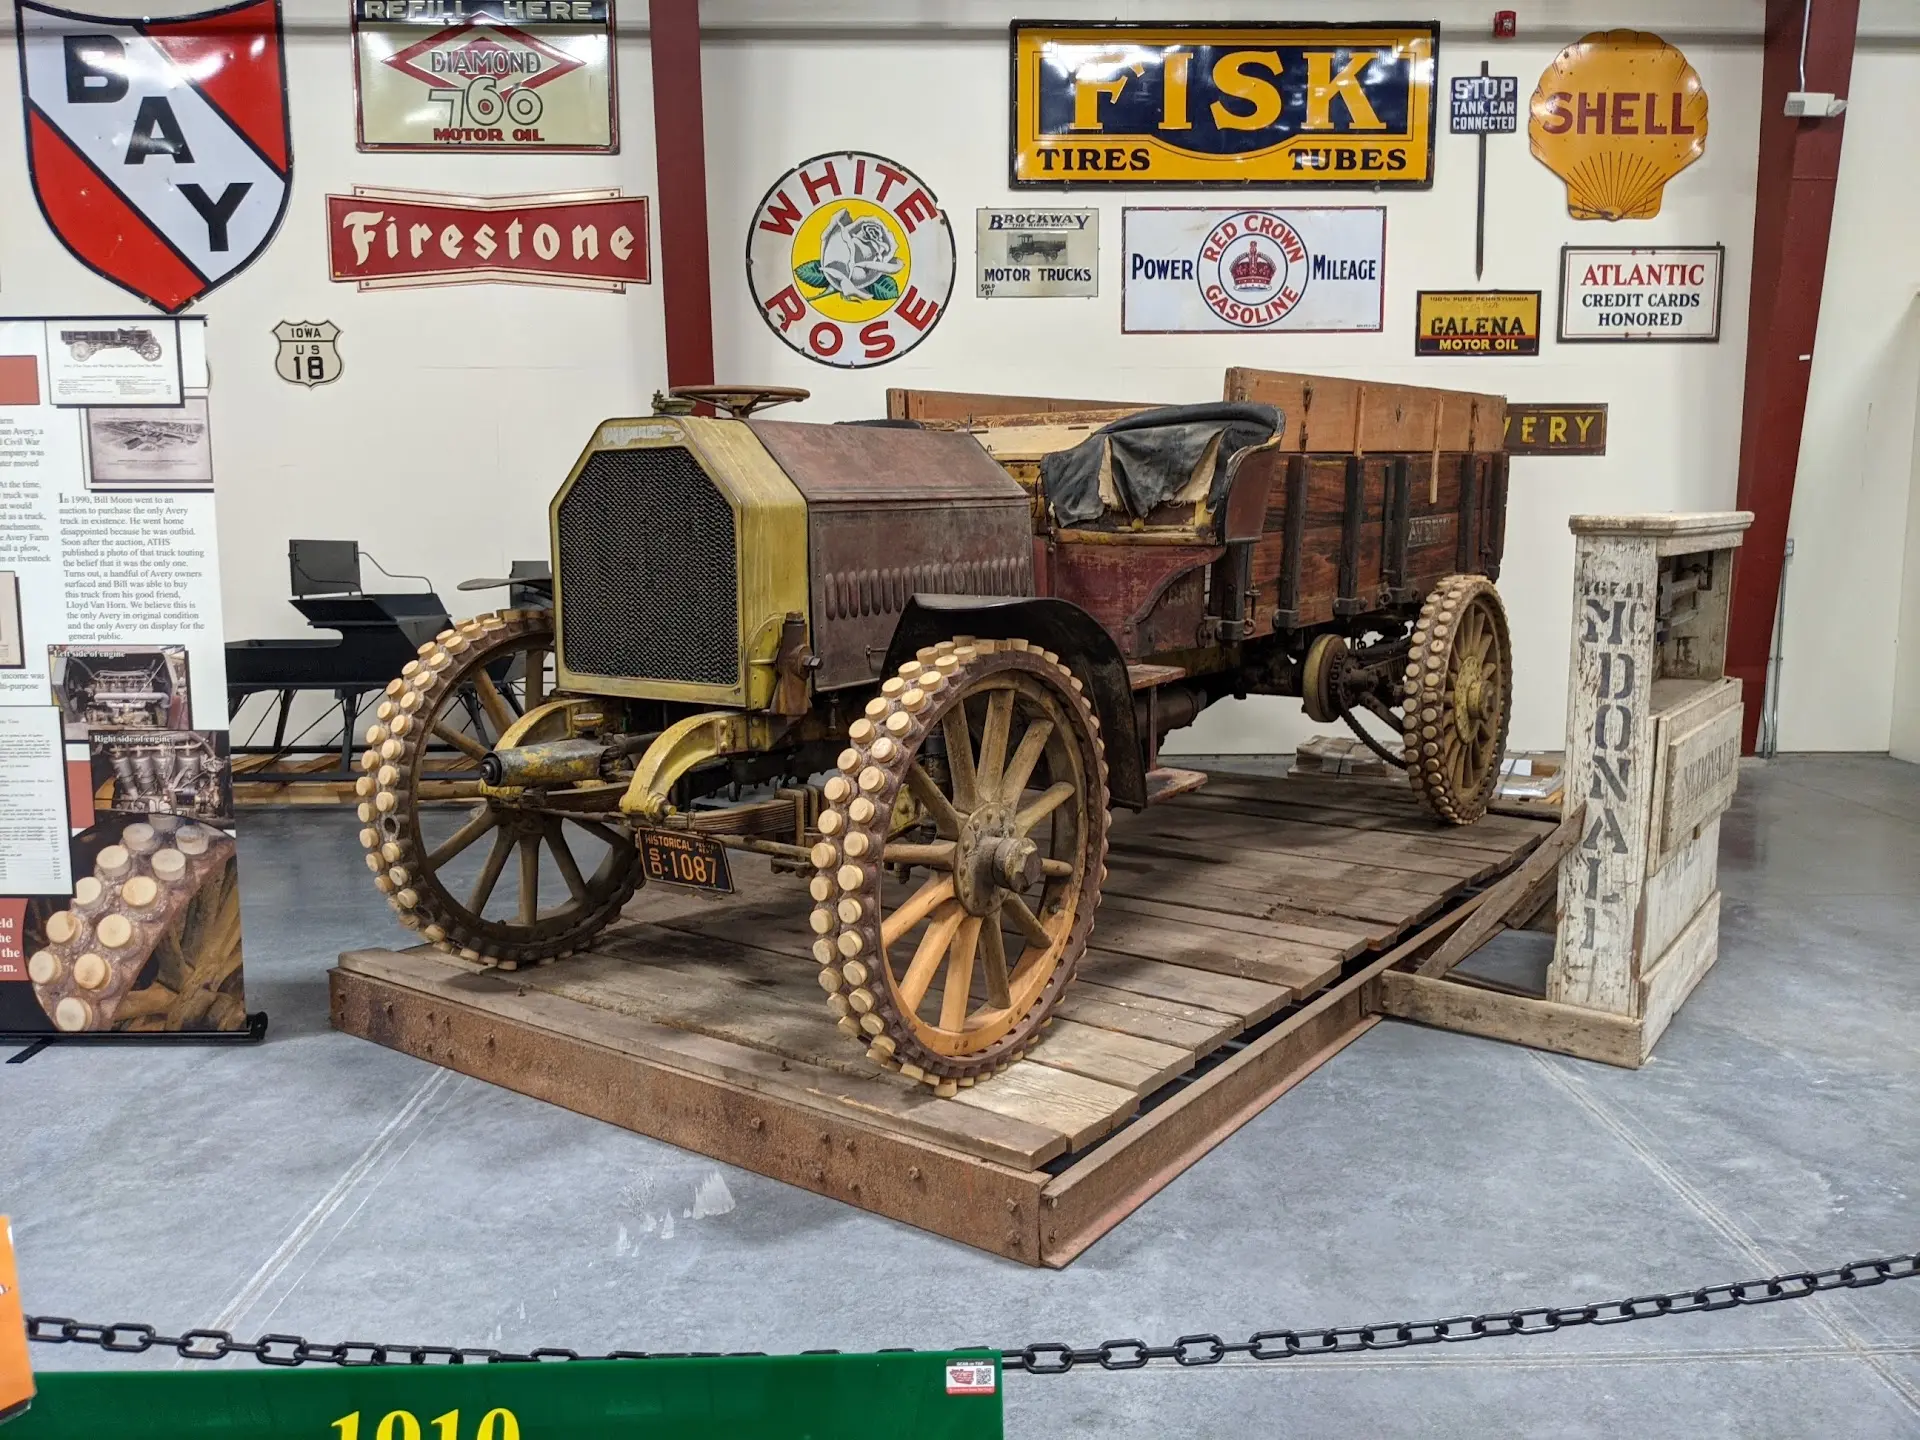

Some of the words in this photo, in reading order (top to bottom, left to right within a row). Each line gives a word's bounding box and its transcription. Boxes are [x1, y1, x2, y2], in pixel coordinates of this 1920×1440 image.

[365, 1, 467, 20] REFILL
[504, 1, 593, 20] HERE
[430, 50, 542, 75] DIAMOND
[1069, 50, 1387, 131] FISK
[1453, 78, 1515, 100] STOP
[428, 75, 543, 127] 760
[1453, 101, 1487, 115] TANK
[1489, 101, 1515, 116] CAR
[1542, 92, 1695, 136] SHELL
[1452, 116, 1515, 131] CONNECTED
[64, 33, 254, 252] BAY
[433, 128, 505, 142] MOTOR
[512, 128, 545, 142] OIL
[1036, 148, 1151, 171] TIRES
[1288, 148, 1407, 171] TUBES
[759, 159, 938, 237] WHITE
[988, 214, 1091, 230] BROCKWAY
[343, 210, 635, 265] Firestone
[1203, 222, 1239, 263] RED
[1244, 214, 1305, 264] CROWN
[1132, 253, 1194, 280] POWER
[1312, 254, 1376, 281] MILEAGE
[984, 268, 1031, 282] MOTOR
[1038, 268, 1092, 282] TRUCKS
[1580, 264, 1705, 287] ATLANTIC
[981, 283, 995, 291] SOLD
[1205, 284, 1300, 324] GASOLINE
[1582, 293, 1644, 308] CREDIT
[1648, 293, 1700, 308] CARDS
[764, 285, 939, 359] ROSE
[1431, 316, 1526, 336] GALENA
[1598, 312, 1683, 327] HONORED
[290, 327, 322, 339] IOWA
[1439, 339, 1490, 351] MOTOR
[1494, 339, 1519, 350] OIL
[293, 356, 324, 380] 18
[72, 496, 92, 506] 1990,
[94, 496, 108, 504] Bill
[110, 496, 133, 504] Moon
[134, 496, 153, 504] went
[59, 506, 87, 514] auction
[98, 506, 131, 516] purchase
[133, 506, 145, 514] the
[146, 506, 164, 516] only
[165, 506, 188, 516] Avery
[60, 527, 108, 537] disappointed
[110, 527, 140, 535] because
[170, 527, 196, 535] outbid.
[115, 538, 146, 547] auction,
[62, 548, 98, 558] published
[106, 548, 128, 558] photo
[140, 548, 154, 556] that
[156, 548, 176, 556] truck
[178, 548, 204, 558] touting
[153, 559, 170, 568] only
[64, 569, 86, 577] Turns
[87, 569, 102, 579] out,
[110, 569, 138, 577] handful
[150, 569, 173, 579] Avery
[174, 580, 188, 589] buy
[65, 590, 80, 598] this
[80, 590, 100, 598] truck
[102, 590, 120, 598] from
[122, 590, 134, 598] his
[135, 590, 154, 600] good
[156, 590, 181, 600] friend,
[66, 600, 88, 610] Lloyd
[90, 600, 105, 608] Van
[106, 600, 128, 608] Horn.
[144, 600, 172, 608] believe
[173, 600, 188, 608] this
[66, 611, 78, 619] the
[80, 611, 97, 621] only
[98, 611, 121, 621] Avery
[132, 611, 161, 621] original
[163, 611, 199, 619] condition
[68, 621, 82, 629] and
[83, 621, 95, 629] the
[96, 621, 113, 631] only
[115, 621, 137, 631] Avery
[150, 621, 178, 631] display
[180, 621, 191, 629] for
[193, 621, 204, 629] the
[68, 632, 96, 642] general
[97, 632, 123, 642] public.
[54, 650, 71, 658] Left
[72, 650, 89, 658] side
[90, 650, 98, 658] of
[99, 650, 126, 659] engine
[94, 735, 115, 744] Right
[116, 735, 132, 743] side
[133, 735, 143, 743] of
[145, 735, 171, 744] engine
[644, 834, 693, 852] HISTORICAL
[670, 851, 717, 884] 1087
[2, 947, 20, 958] the
